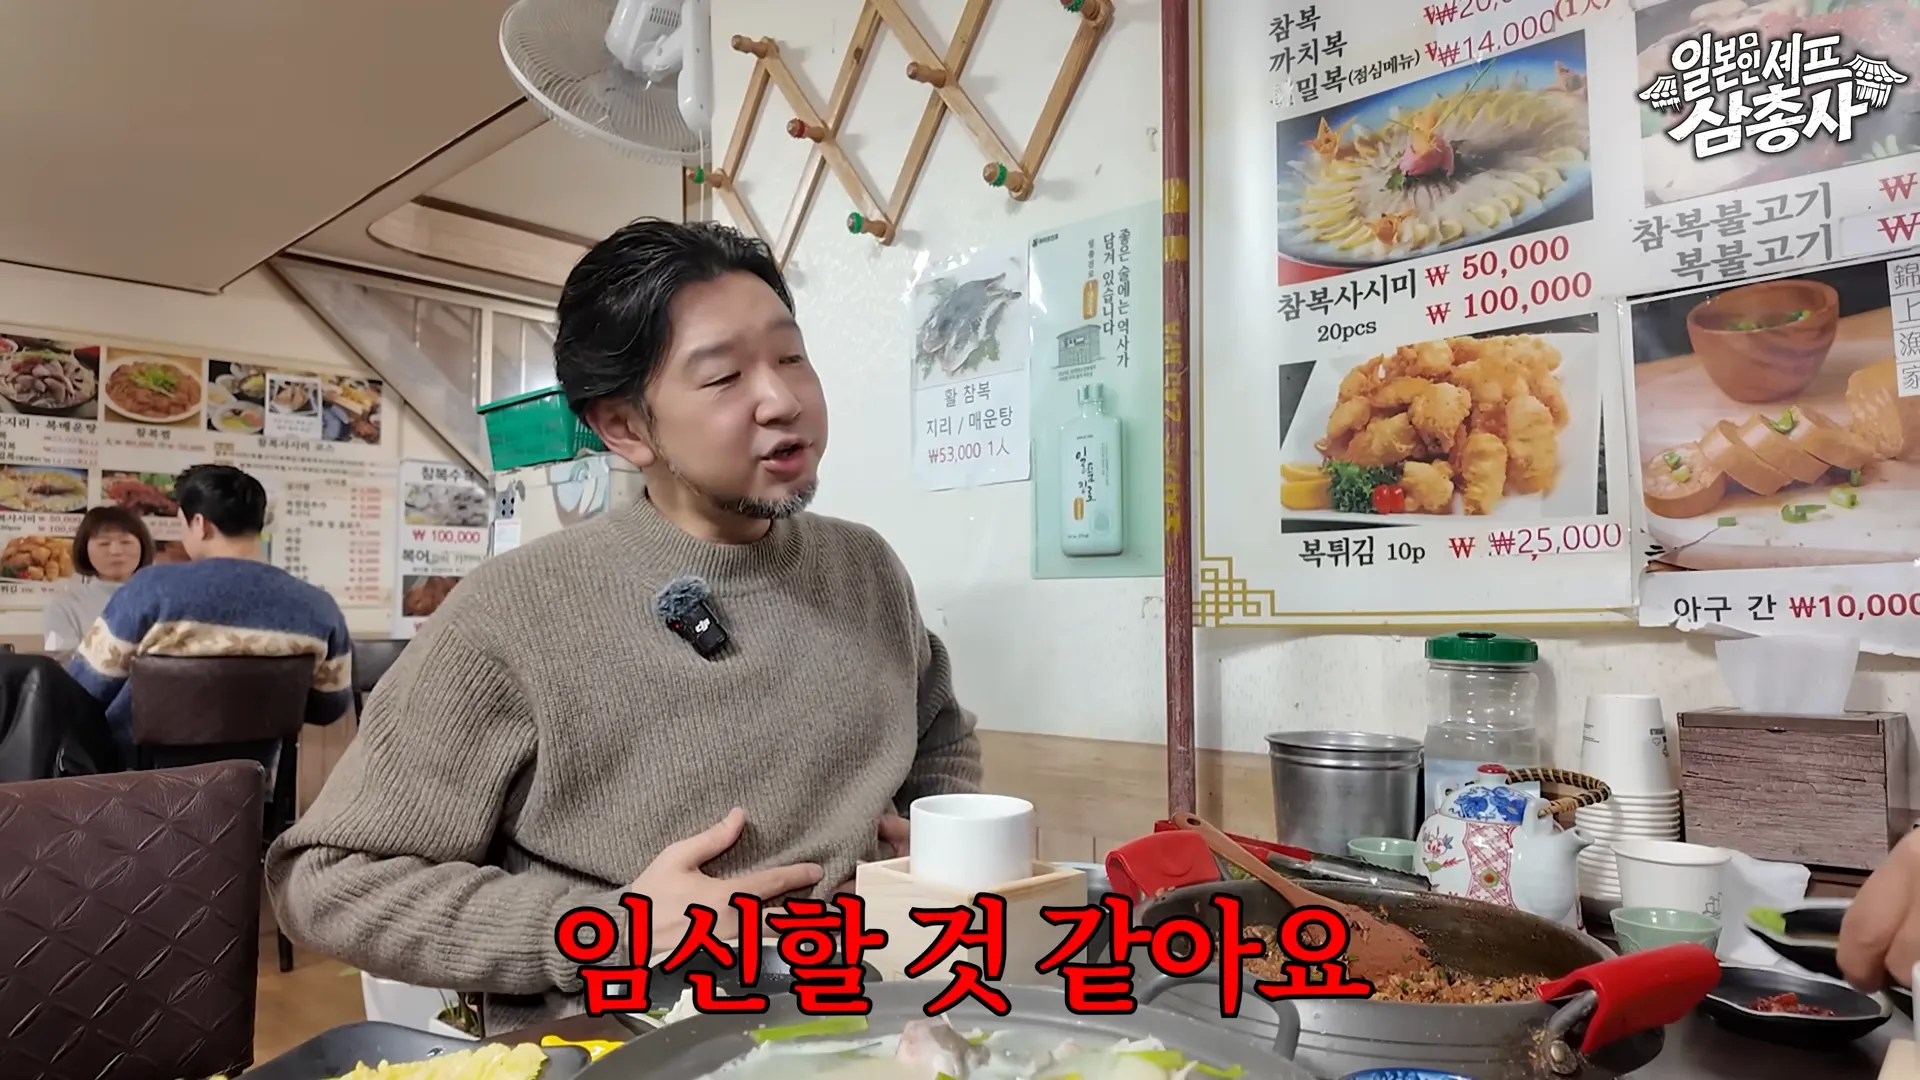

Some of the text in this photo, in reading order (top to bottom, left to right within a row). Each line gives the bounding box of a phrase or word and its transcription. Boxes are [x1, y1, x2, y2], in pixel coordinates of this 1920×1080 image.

[1268, 5, 1322, 43] 참복
[1269, 30, 1348, 74] 까치복
[1632, 182, 1831, 253] 참복불고기
[1671, 224, 1832, 282] 복불고기
[1102, 232, 1115, 335] 담겨 있습니다
[1117, 228, 1130, 368] 좋은 술에는 역사가
[1277, 268, 1416, 322] 참복사시미
[1462, 235, 1570, 280] 50,000
[1317, 321, 1377, 343] 20pcs
[1464, 271, 1592, 319] 100,000
[944, 381, 991, 407] 활 참복
[926, 416, 951, 437] 지리
[968, 405, 1013, 430] 매운탕
[928, 437, 1010, 464] ₩53,000 1人
[432, 530, 480, 543] 100,000
[1298, 536, 1375, 568] 복튀김
[1387, 541, 1425, 564] 10p
[1489, 523, 1622, 556] ₩25,000
[1674, 594, 1920, 622] 아구 간 ₩10,000
